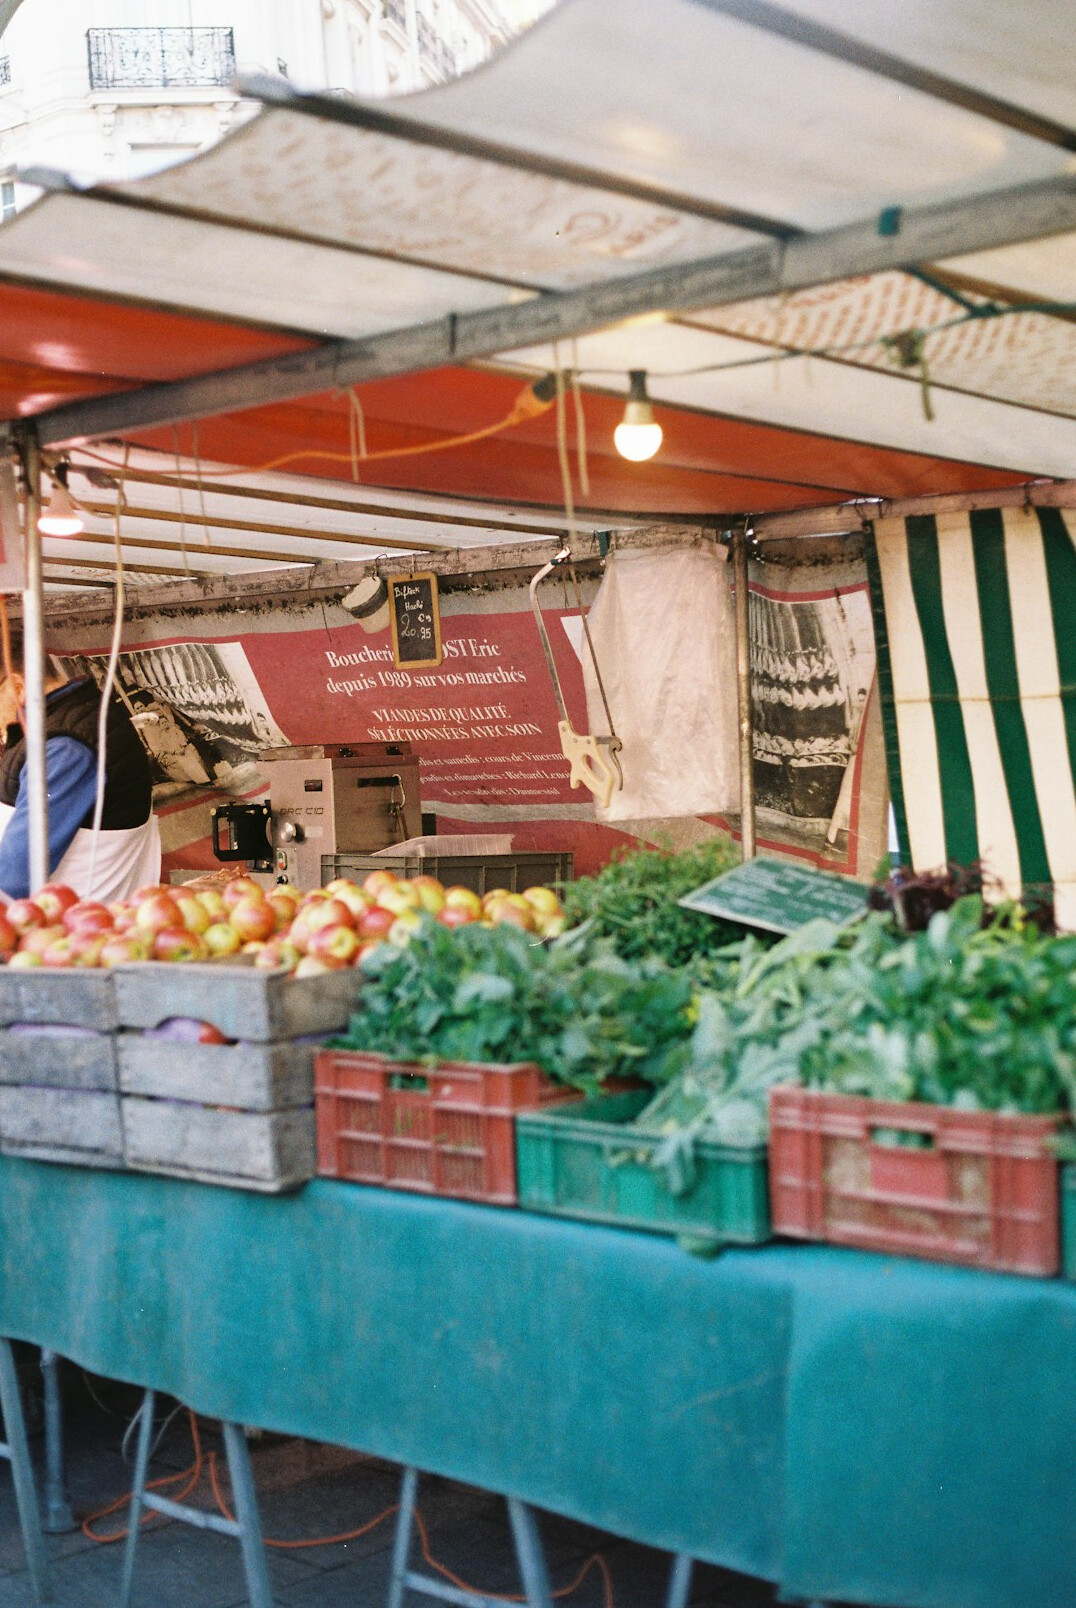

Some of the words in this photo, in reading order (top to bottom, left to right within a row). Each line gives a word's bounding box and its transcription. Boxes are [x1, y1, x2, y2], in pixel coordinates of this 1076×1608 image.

[325, 644, 394, 668] Boucheri
[470, 638, 502, 657] Eric
[326, 672, 378, 697] depuis
[379, 670, 412, 689] 1989
[413, 675, 438, 687] sur
[437, 673, 465, 687] vos
[465, 665, 528, 685] marchés
[372, 708, 431, 722] VIANDES
[429, 708, 451, 721] DE
[449, 702, 511, 724] QUALITÉ
[470, 726, 508, 739] AVEC
[505, 722, 543, 737] SOIN
[511, 753, 524, 762] de
[521, 752, 566, 761] Vincenn
[504, 771, 544, 779] Richard
[542, 770, 571, 779] Lenoi
